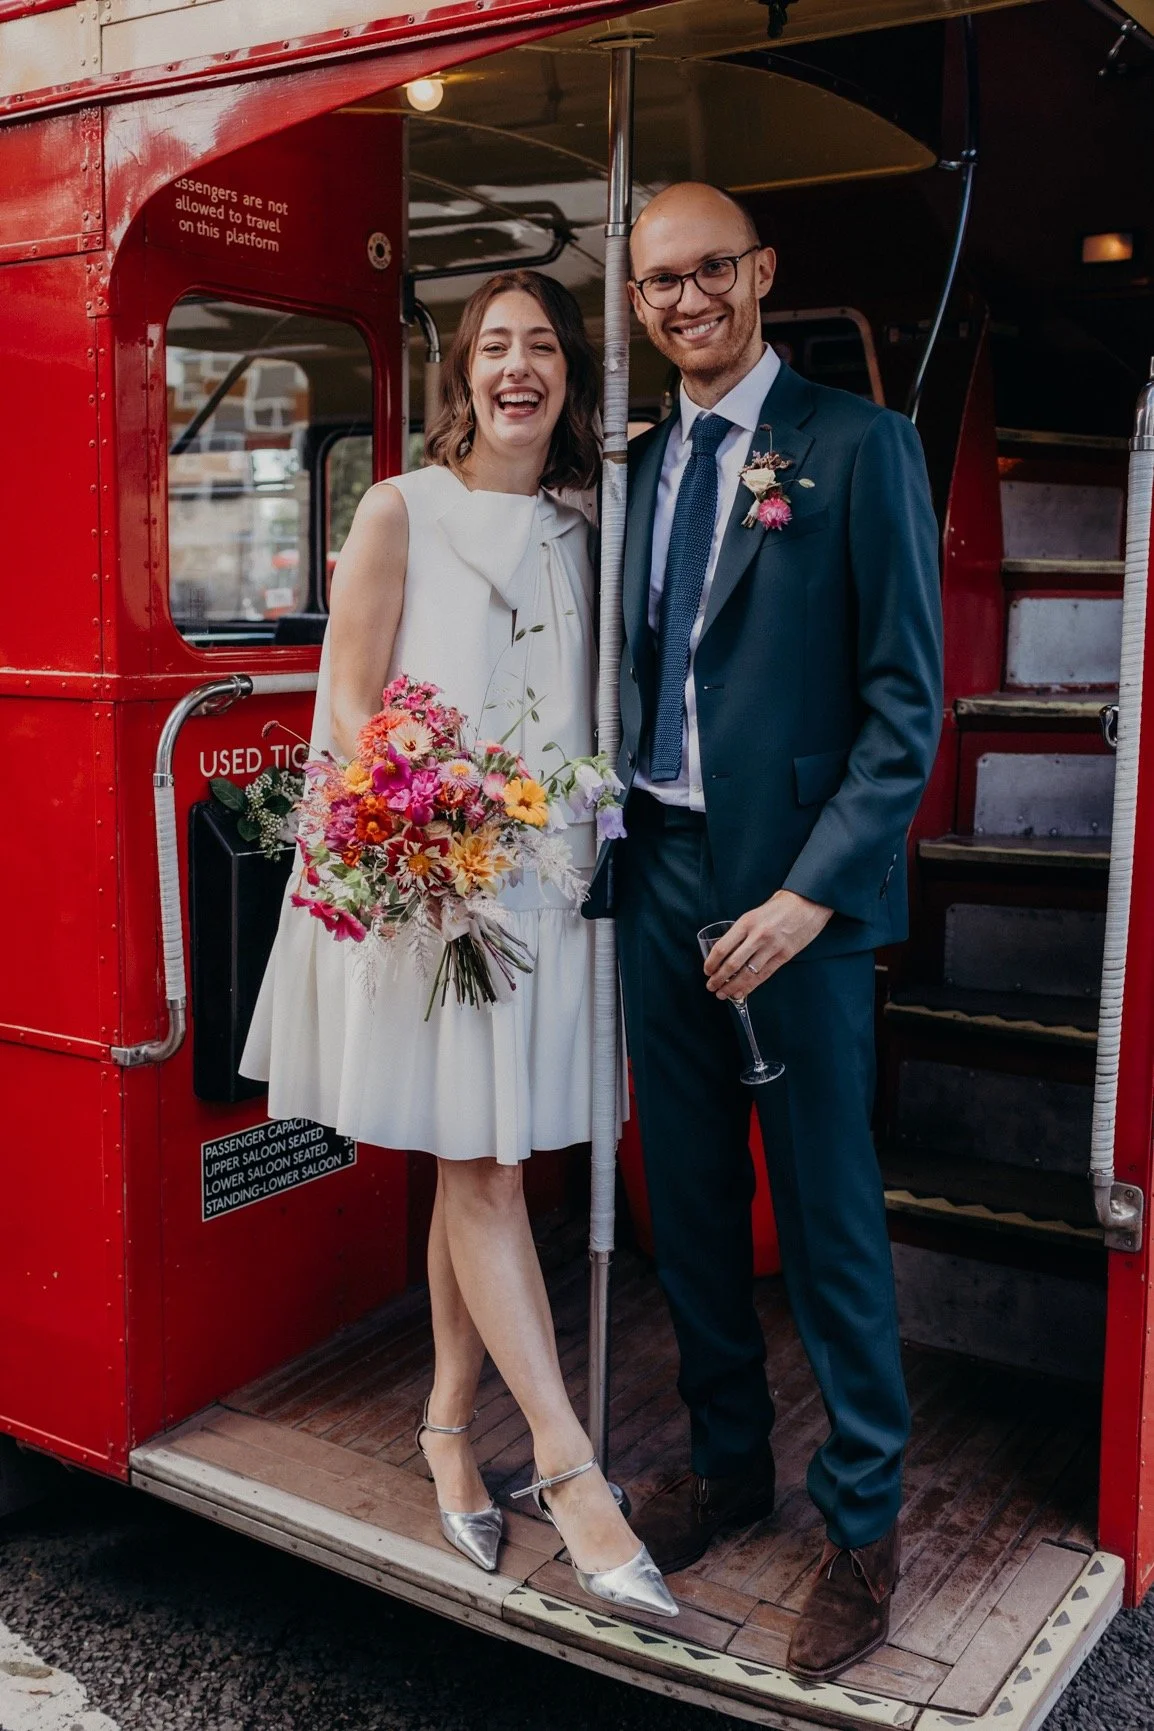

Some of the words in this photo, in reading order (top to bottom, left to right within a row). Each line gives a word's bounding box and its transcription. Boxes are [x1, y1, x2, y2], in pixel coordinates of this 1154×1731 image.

[174, 178, 238, 203] assengers
[243, 194, 263, 209] are
[268, 200, 289, 215] not
[175, 194, 225, 219] allowed
[229, 208, 242, 223] to
[246, 213, 281, 233] travel
[179, 219, 194, 232] on
[196, 220, 220, 239] this
[226, 227, 280, 252] platform
[200, 747, 262, 777] USED
[270, 743, 308, 769] TIC
[205, 1129, 265, 1161] PASSENGER
[205, 1152, 240, 1178] UPPER
[242, 1140, 286, 1169] SALOON
[288, 1127, 324, 1149] SEATED
[205, 1172, 245, 1197] LOWER
[247, 1155, 291, 1181] SALOON
[293, 1142, 328, 1165] SEATED
[205, 1170, 300, 1215] STANDING-LOWER
[301, 1153, 342, 1179] SALOON
